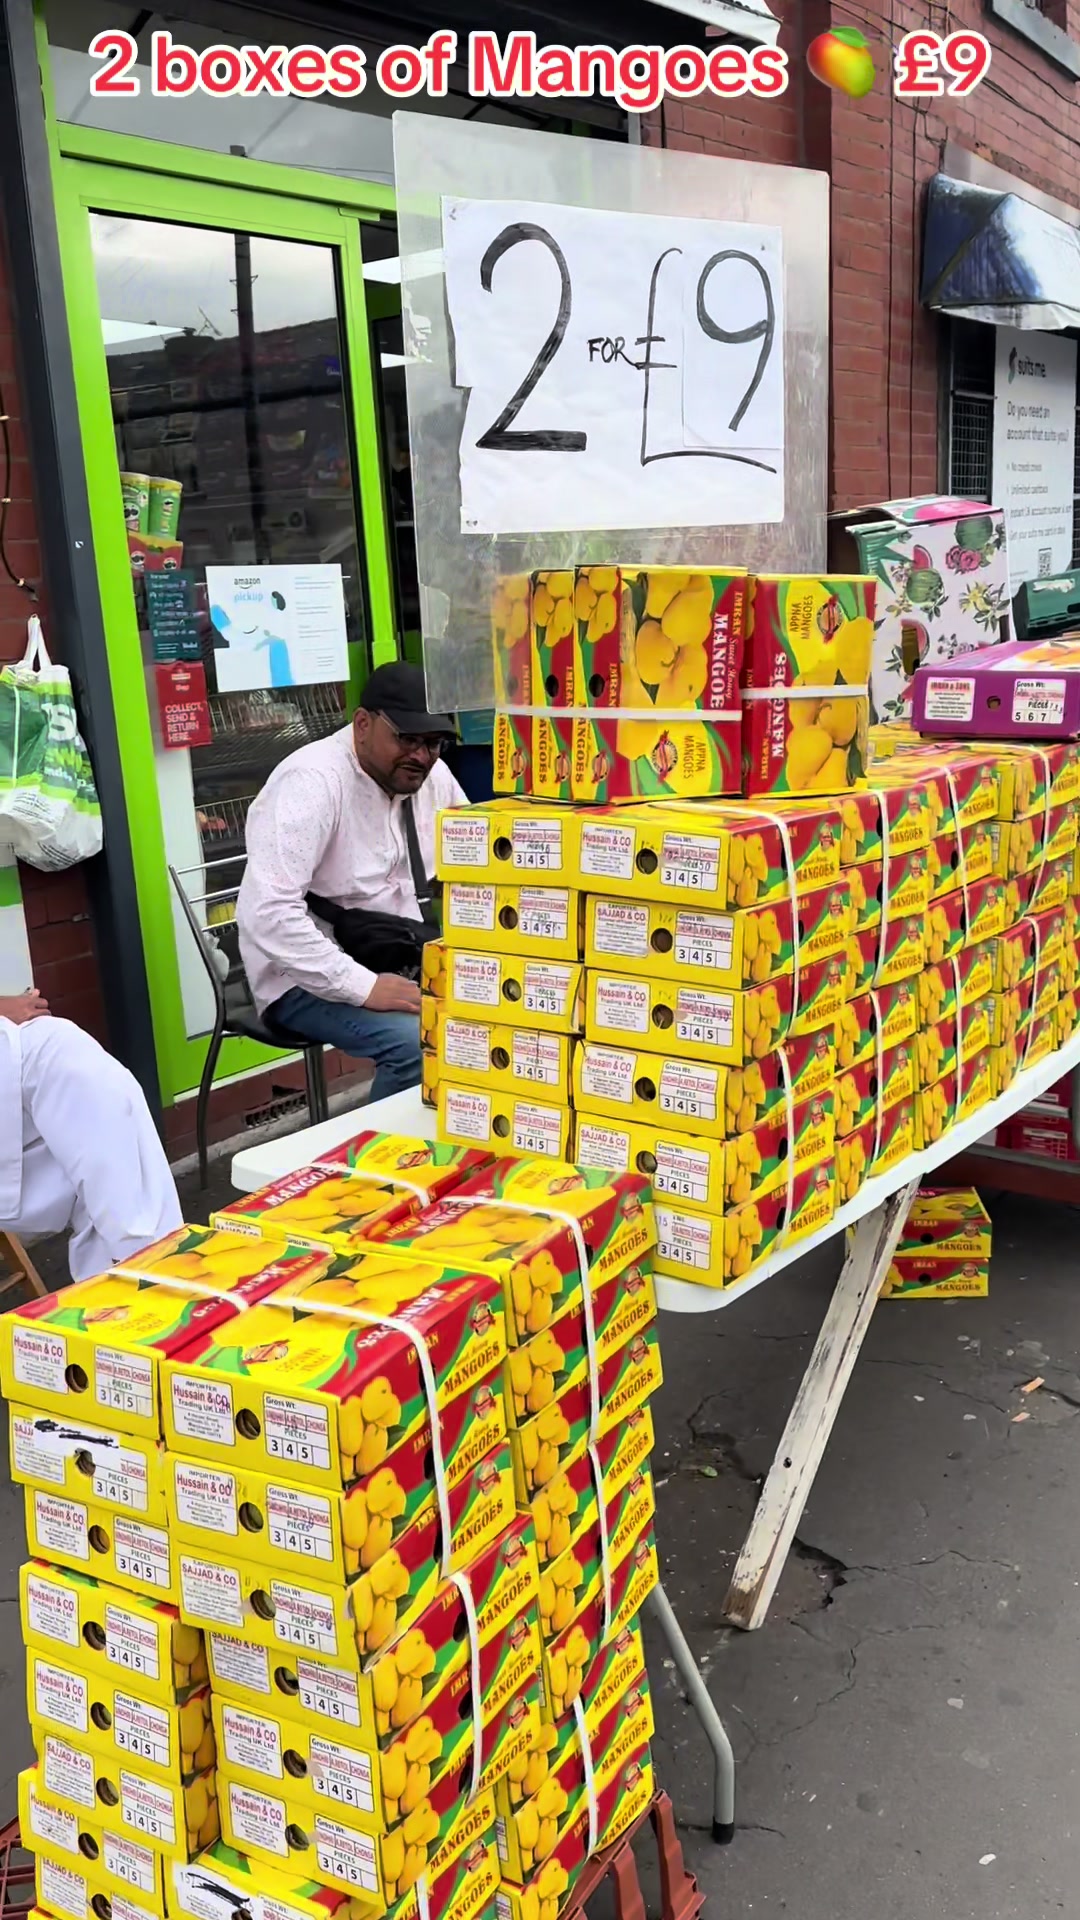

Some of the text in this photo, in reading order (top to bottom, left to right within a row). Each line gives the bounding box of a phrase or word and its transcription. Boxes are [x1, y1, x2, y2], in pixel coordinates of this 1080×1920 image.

[475, 221, 777, 473] 2 FOR £9
[1018, 355, 1034, 376] suits
[1007, 401, 1015, 416] Do
[234, 577, 261, 586] amazon
[234, 591, 263, 603] pickup
[790, 603, 801, 632] APPNA
[801, 595, 813, 639] MANGOES
[727, 591, 743, 699] IMRAN Sweet Honey
[710, 612, 729, 709] MANGOE
[609, 663, 617, 708] IMRAN
[165, 702, 204, 713] COLLECT,
[166, 712, 196, 722] SEND &
[1015, 712, 1047, 721] 5 6 7
[167, 720, 199, 732] RETURN
[168, 731, 192, 742] HERE.
[498, 714, 507, 780] ANGOES
[539, 718, 548, 783] ANGOES
[576, 718, 586, 783] ANGOES
[683, 735, 694, 779] MANGOES
[696, 742, 706, 771] APPNA
[761, 738, 769, 779] IMRAN
[597, 908, 646, 921] SAJJAD & CO
[679, 949, 712, 963] 3 4 5
[527, 998, 556, 1010] 3 4 5
[805, 1000, 842, 1025] MANGOES
[586, 1066, 607, 1076] Trading
[613, 1060, 618, 1070] &
[620, 1062, 631, 1072] CO
[665, 1064, 681, 1072] Gross
[676, 1089, 696, 1098] PIECES
[664, 1098, 697, 1113] 3 4 5
[581, 1129, 626, 1147] SAJJAD & CO
[671, 1170, 690, 1179] PIECES
[658, 1177, 689, 1194] 3 4 5
[789, 1203, 831, 1236] MANGOES
[599, 1227, 648, 1272] MANGOES
[937, 1243, 982, 1251] MANGOES
[936, 1284, 981, 1292] MANGOES
[602, 1300, 650, 1347] MANGOES
[444, 1341, 500, 1396] MANGOES
[606, 1368, 654, 1417] MANGOES
[448, 1423, 500, 1481] MANGOES
[608, 1432, 649, 1484] MANGOES
[177, 1474, 209, 1491] Hussain
[211, 1481, 216, 1493] &
[189, 1469, 221, 1481] IMPORTER
[181, 1487, 229, 1504] Trading UK Ltd
[269, 1488, 288, 1499] Gross
[37, 1502, 84, 1525] Hussain & CO
[287, 1520, 310, 1532] PIECES
[613, 1499, 650, 1553] MANGOES
[274, 1531, 312, 1550] 3 4 5
[120, 1559, 152, 1578] 3 4 5
[182, 1563, 237, 1586] SAJJAD & CO
[477, 1570, 532, 1634] MANGOES
[617, 1571, 655, 1626] MANGOES
[279, 1625, 315, 1645] 3 4 5
[482, 1650, 535, 1716] MANGOES
[593, 1657, 639, 1713] MANGOES
[225, 1717, 276, 1743] Hussain & CO
[236, 1714, 267, 1727] IMPORTER
[229, 1729, 274, 1750] Trading UK Ltd
[312, 1738, 329, 1749] Gross
[601, 1717, 648, 1775] MANGOES
[329, 1770, 352, 1784] PIECES
[318, 1778, 353, 1800] 3 4 5
[600, 1791, 647, 1846] MANGOES
[430, 1805, 491, 1875] MANGOES
